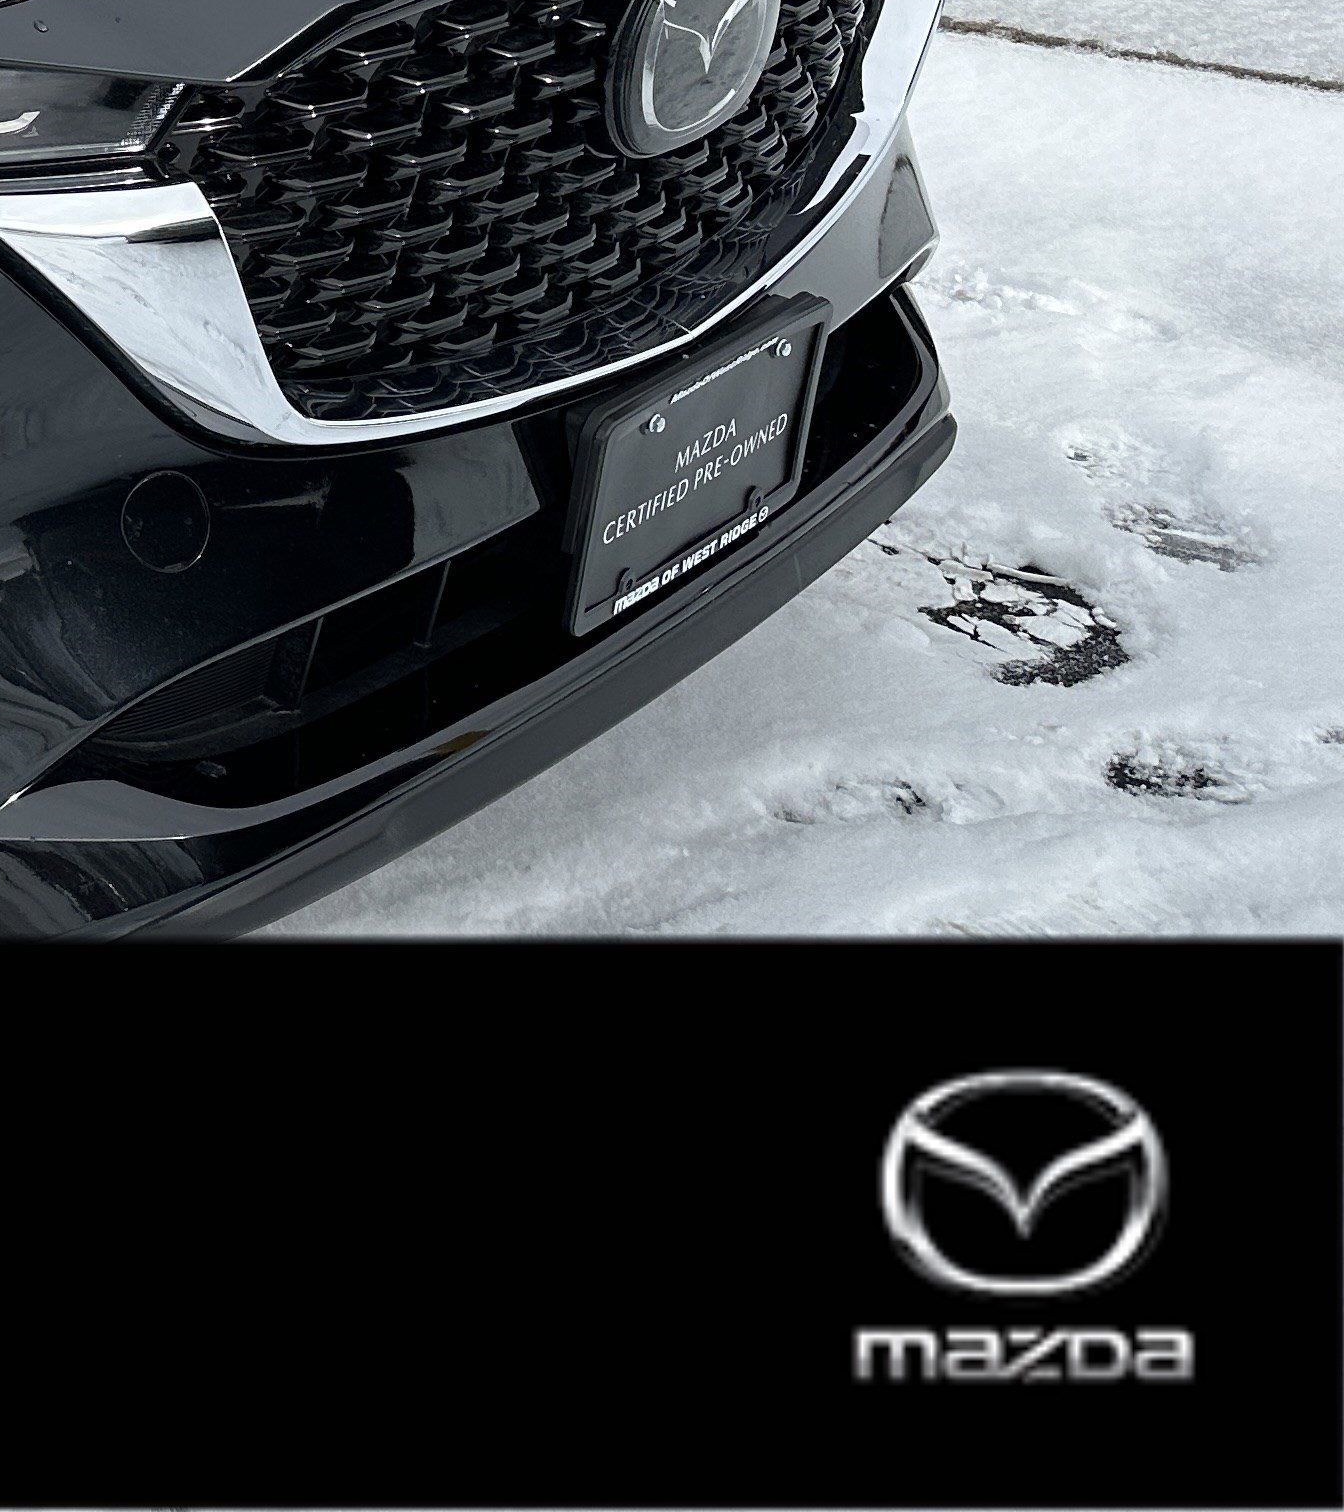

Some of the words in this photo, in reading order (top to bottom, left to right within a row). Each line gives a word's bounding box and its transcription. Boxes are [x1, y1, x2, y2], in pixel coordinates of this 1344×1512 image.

[602, 477, 690, 546] CERTIFIED
[693, 412, 789, 492] PRE-OWNED
[674, 417, 738, 474] MAZDA
[661, 566, 682, 587] OF
[682, 539, 718, 573] WEST
[719, 515, 759, 550] RIDGE
